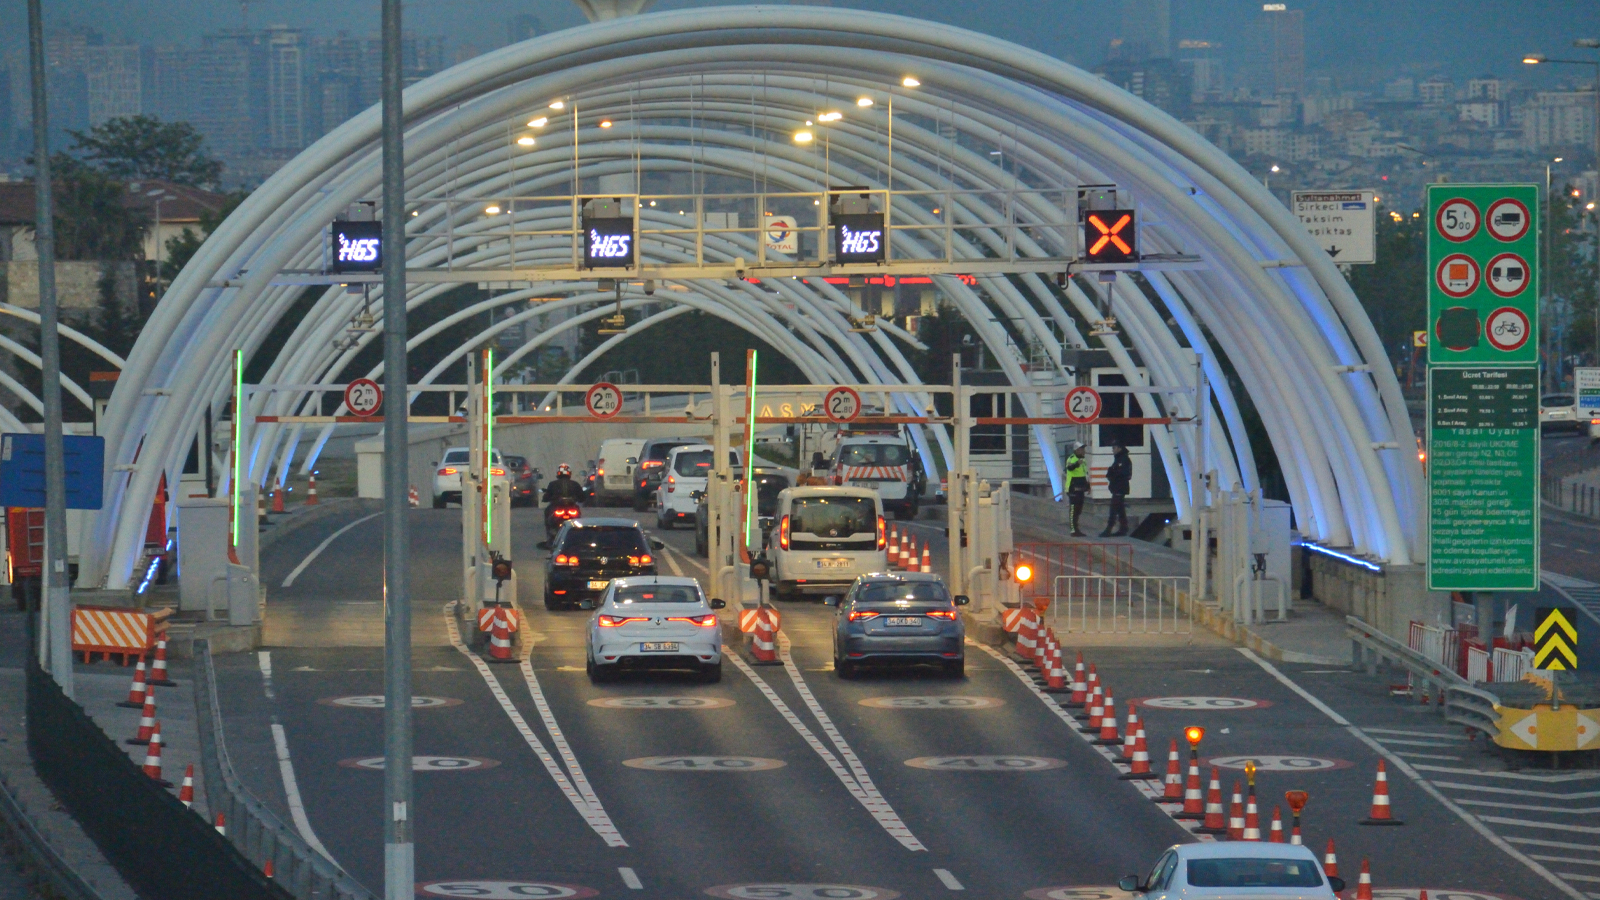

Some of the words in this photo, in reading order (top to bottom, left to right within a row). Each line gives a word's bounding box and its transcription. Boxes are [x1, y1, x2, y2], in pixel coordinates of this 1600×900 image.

[1299, 202, 1339, 211] Sirkeci
[1299, 215, 1344, 223] Taksim
[1308, 228, 1352, 236] eşiktaş
[591, 236, 630, 257] HGS
[842, 231, 881, 252] HGS
[339, 239, 379, 260] HGS
[354, 389, 362, 405] 2
[594, 393, 603, 409] 2
[832, 397, 842, 413] 2
[1073, 396, 1082, 412] 2
[1489, 429, 1519, 437] Uyarı
[1486, 508, 1530, 516] ödenmeyen
[656, 760, 756, 768] 40
[937, 759, 1036, 768] 40
[1223, 758, 1322, 768] 40
[438, 884, 562, 896] 50
[746, 887, 863, 898] 50
